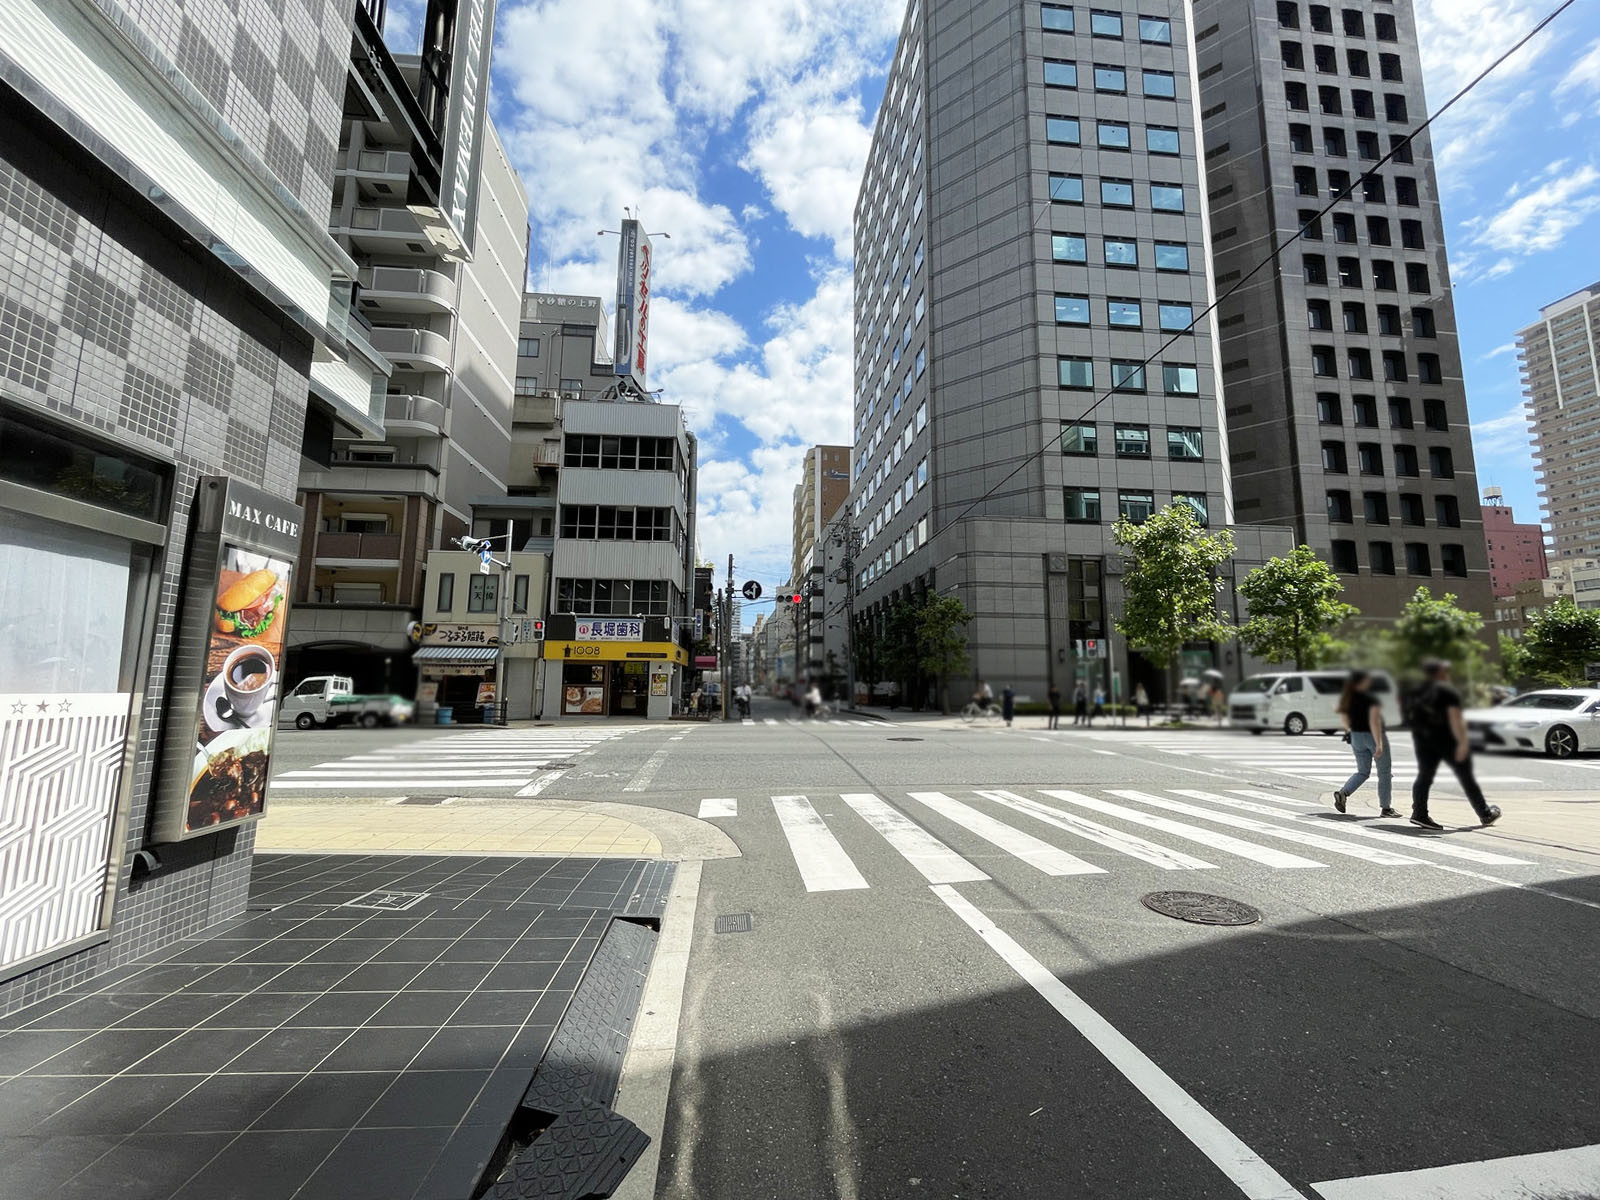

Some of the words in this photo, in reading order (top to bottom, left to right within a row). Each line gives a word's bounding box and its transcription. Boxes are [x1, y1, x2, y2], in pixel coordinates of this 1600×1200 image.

[468, 0, 484, 61] TEL
[228, 497, 261, 525] MAX
[265, 513, 299, 537] CAFE
[591, 622, 641, 637] 長堀歯科
[573, 646, 600, 656] 1008
